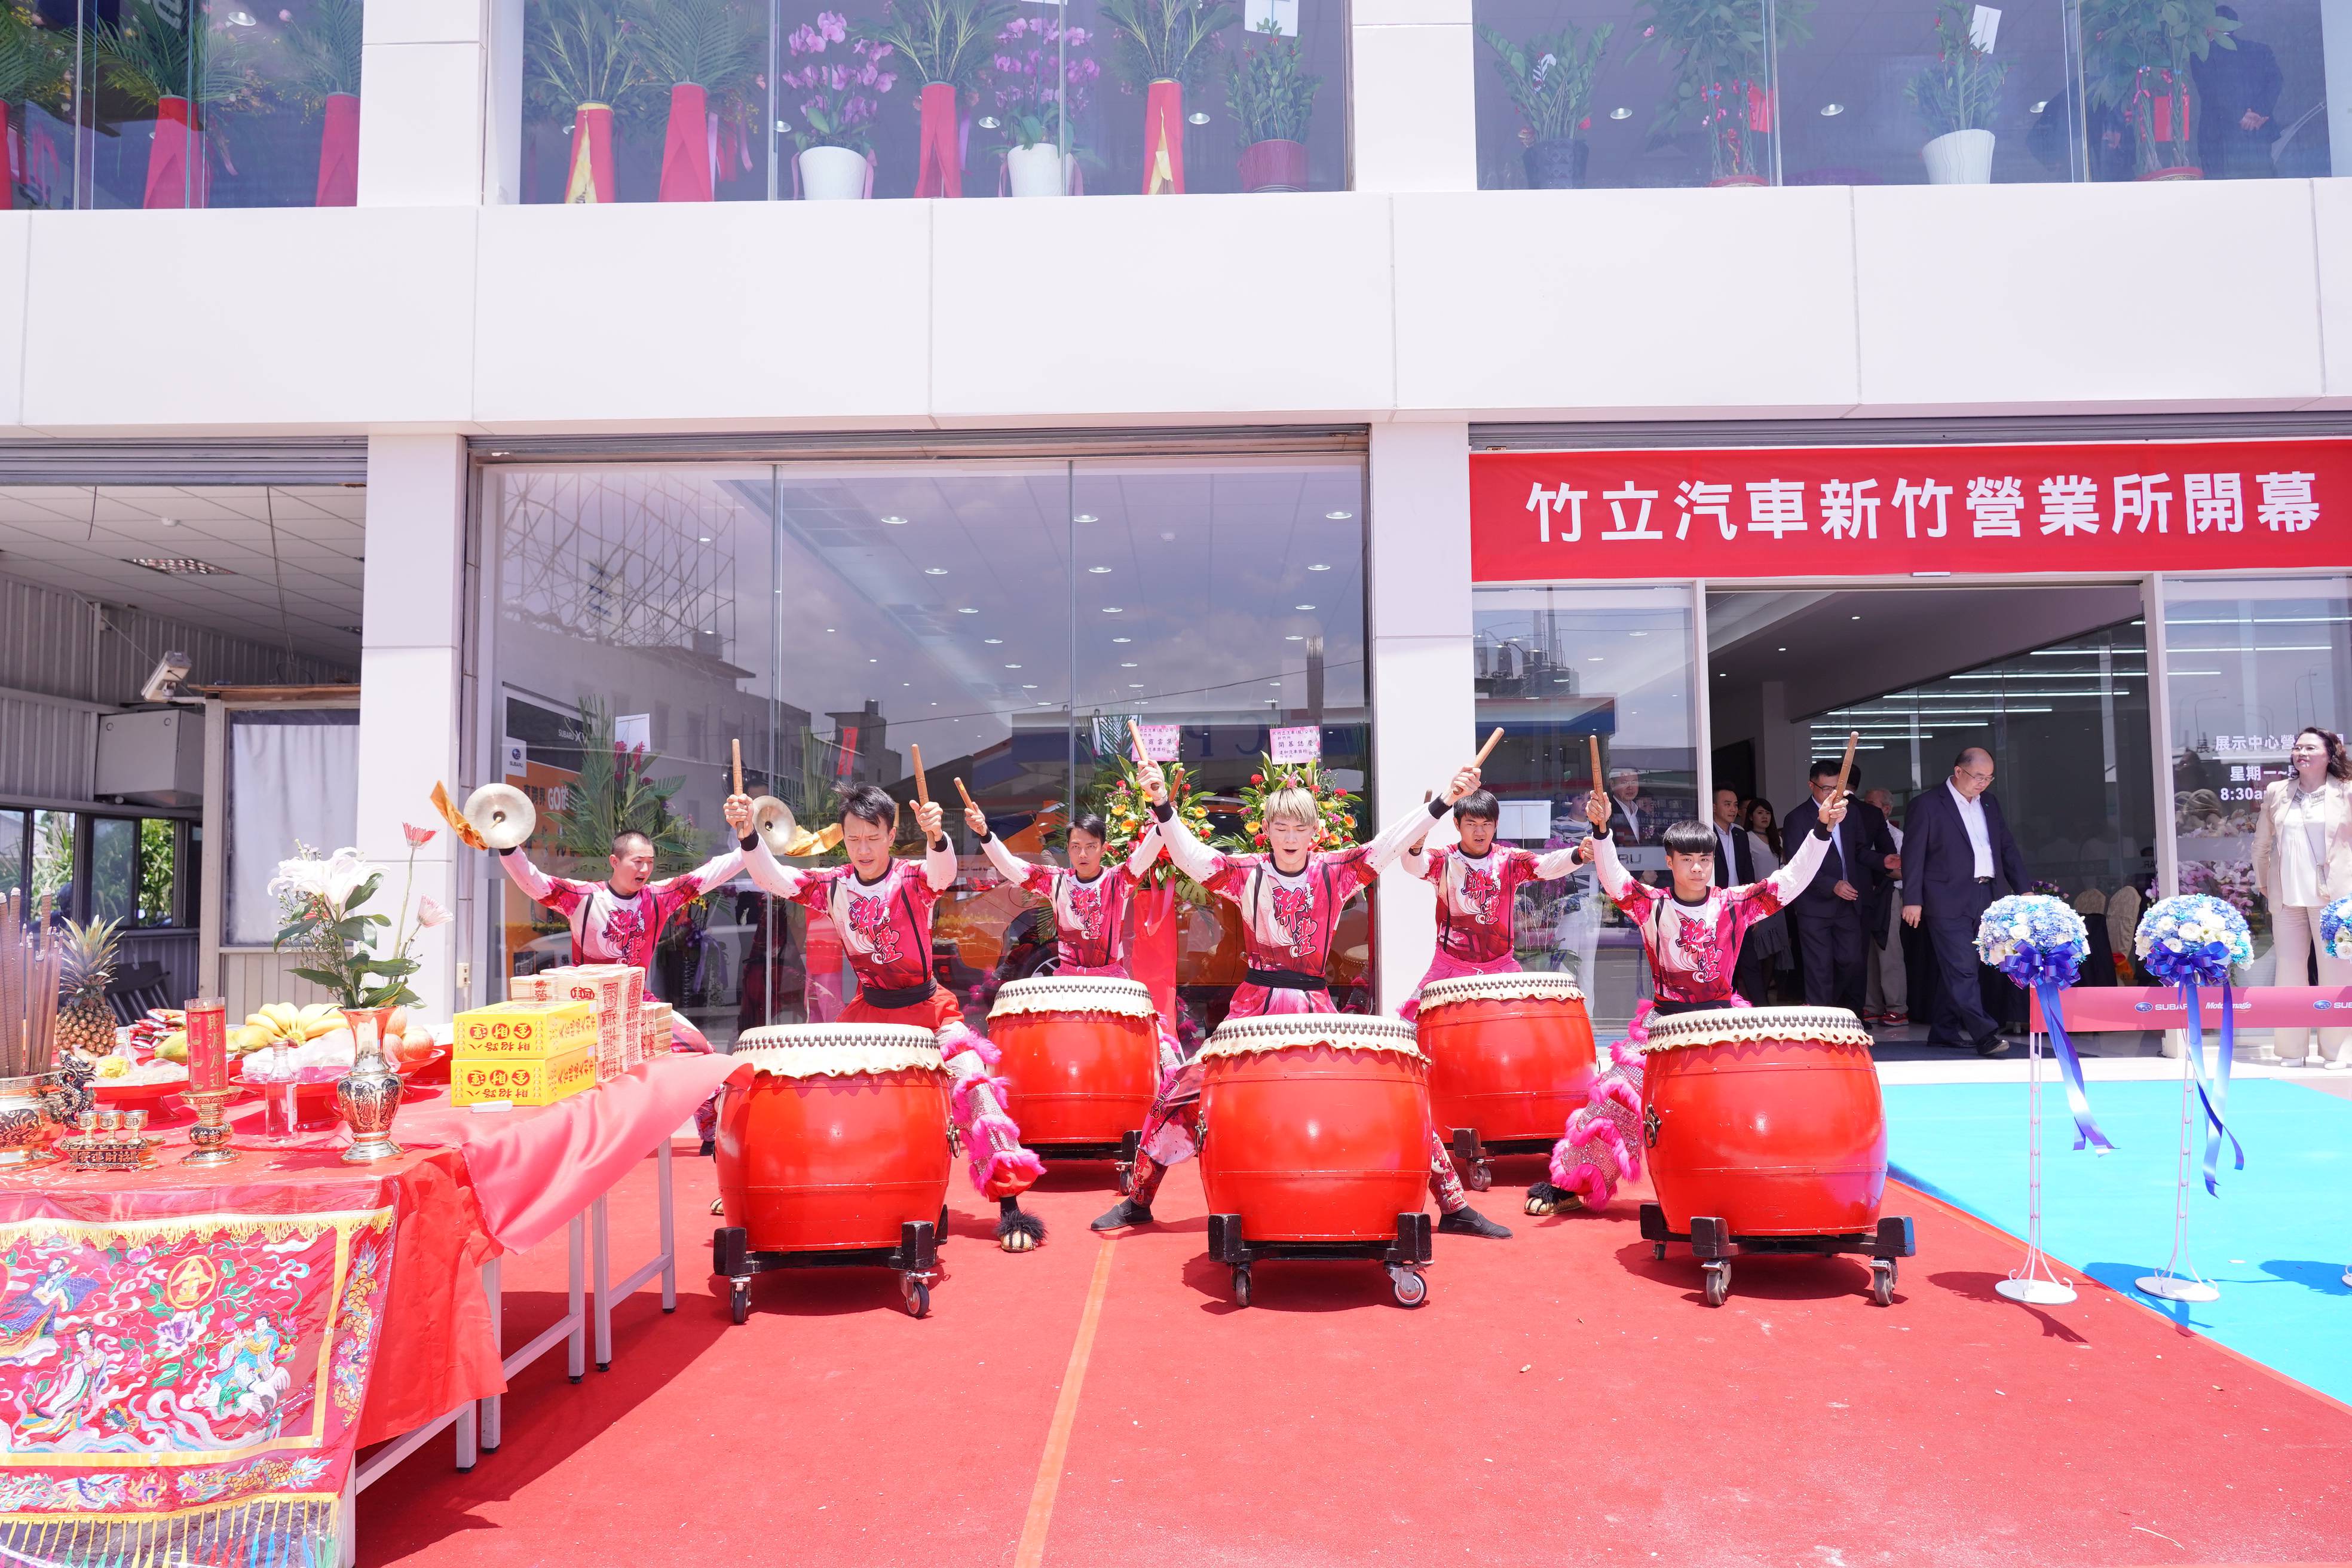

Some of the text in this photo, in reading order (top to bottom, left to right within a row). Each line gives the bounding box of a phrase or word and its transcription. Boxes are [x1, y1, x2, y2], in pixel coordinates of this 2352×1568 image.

[1525, 471, 2320, 543] 竹立汽車新竹營業所開幕
[2216, 734, 2344, 751] 展示中心營
[2220, 787, 2267, 801] 8:30a
[2205, 1002, 2252, 1010] Moto mage
